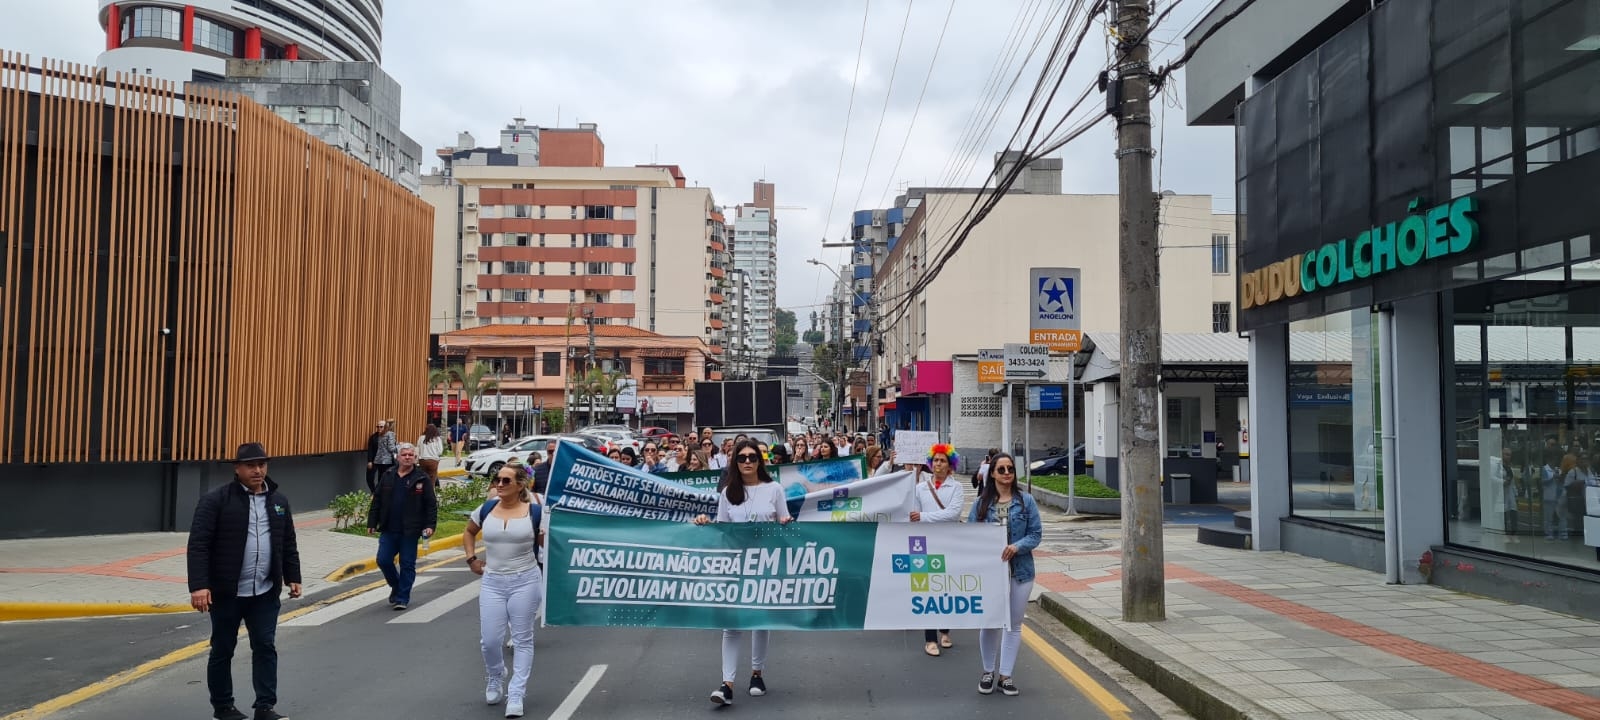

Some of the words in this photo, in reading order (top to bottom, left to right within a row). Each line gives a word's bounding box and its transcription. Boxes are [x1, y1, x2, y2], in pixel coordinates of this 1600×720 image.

[1034, 332, 1078, 341] ENTRADA
[1008, 358, 1045, 367] 3433-3424
[570, 463, 614, 485] PATRÕES
[613, 473, 621, 486] E
[622, 475, 640, 490] STF
[639, 479, 653, 493] SE
[696, 476, 709, 485] DA
[558, 494, 565, 506] A
[567, 496, 644, 518] ENFERMAGEM
[565, 476, 592, 495] PISO
[592, 482, 640, 503] SALARIAL
[641, 492, 656, 507] DA
[657, 497, 719, 515] ENFERMAG
[570, 548, 625, 569] NOSSA
[626, 551, 665, 572] LUTA
[666, 552, 700, 573] NÃO
[701, 553, 742, 575] SERÁ
[743, 547, 782, 576] EM
[785, 541, 840, 576] VÃO.
[576, 577, 678, 600] DEVOLVAM
[679, 581, 739, 603] NOSSO
[741, 577, 837, 604] DIREITO!
[930, 574, 982, 592] SINDI
[911, 592, 984, 615] SAÚDE
